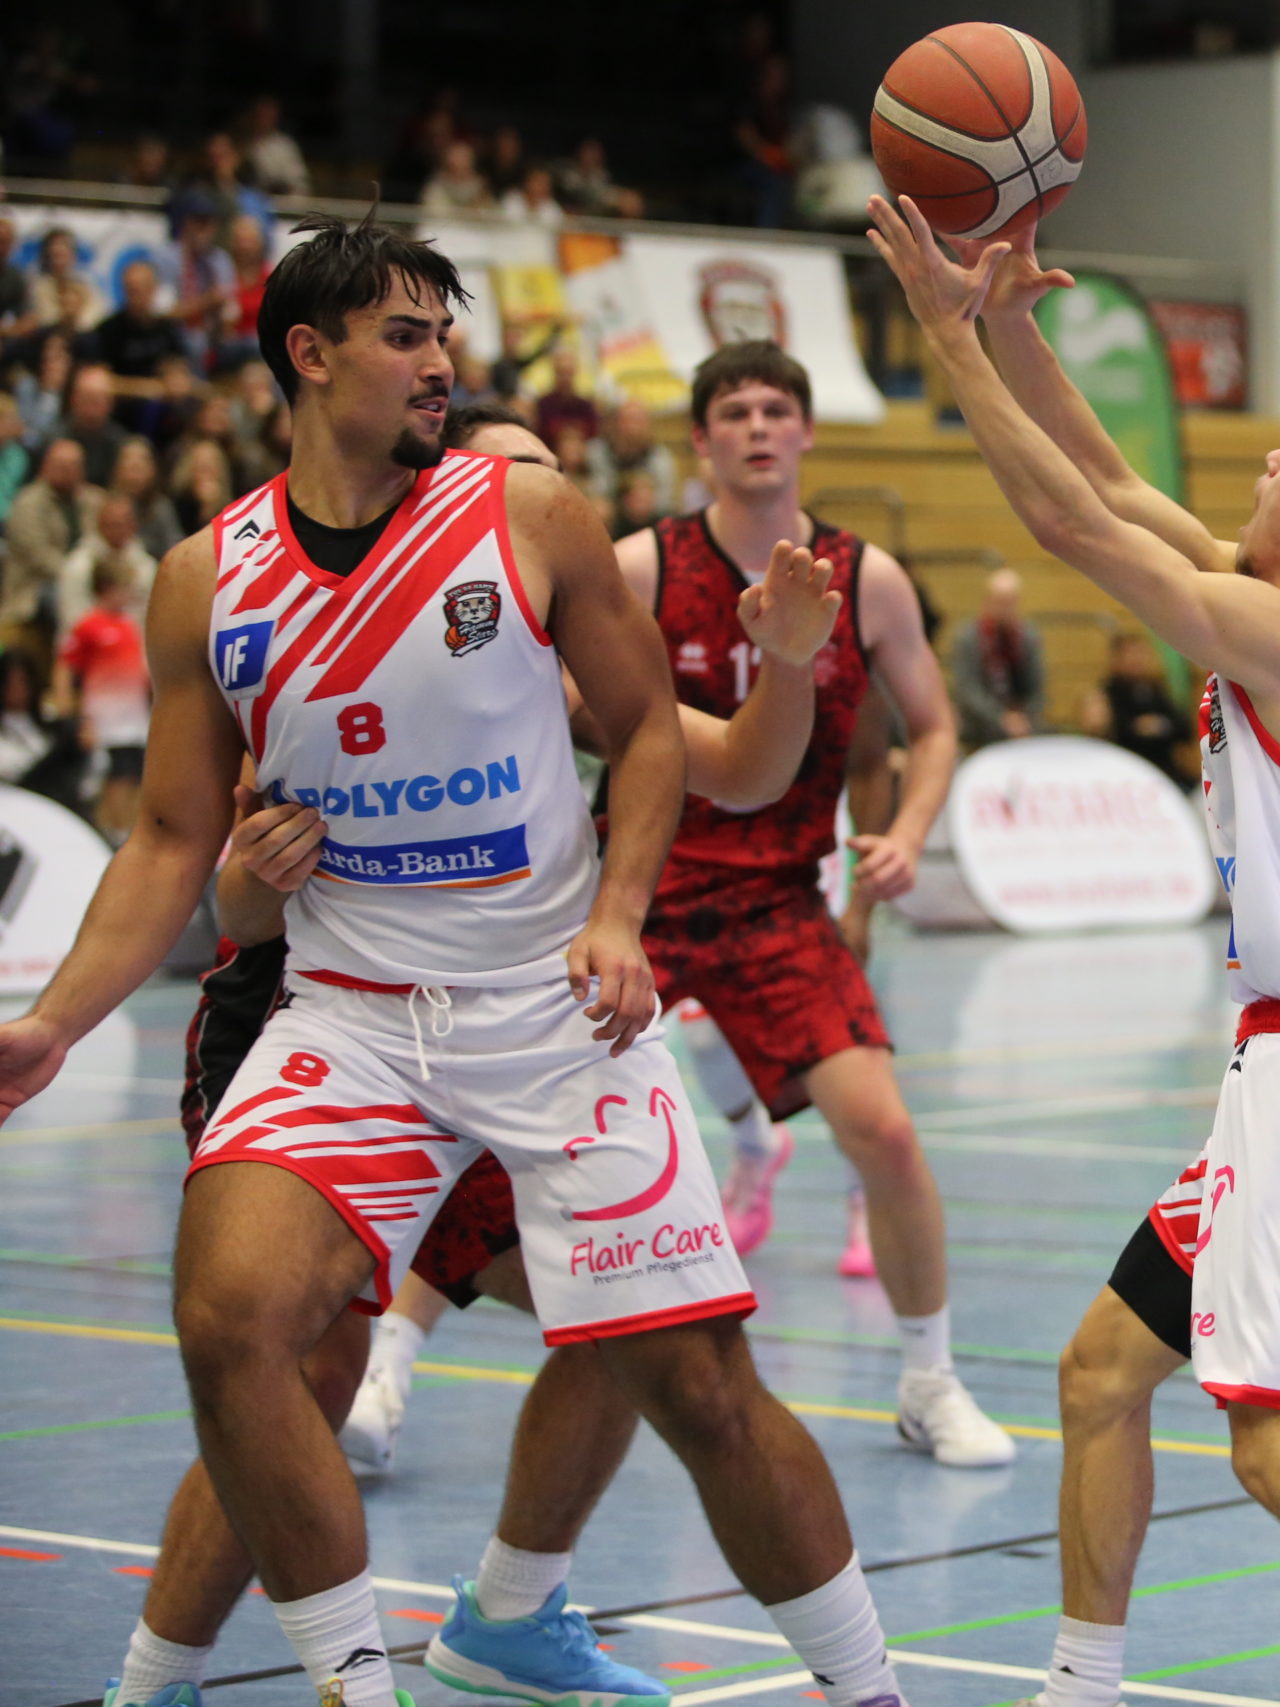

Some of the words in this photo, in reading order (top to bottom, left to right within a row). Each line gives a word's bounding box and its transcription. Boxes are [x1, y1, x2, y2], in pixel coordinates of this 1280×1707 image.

[222, 634, 250, 688] JF
[336, 701, 387, 756] 8
[294, 754, 521, 818] POLYGON
[320, 845, 495, 876] arda-Bank
[278, 1051, 332, 1087] 8
[571, 1232, 645, 1276] Flair
[652, 1222, 724, 1259] Care
[593, 1267, 644, 1285] Premium
[647, 1252, 715, 1275] Pflegedienst
